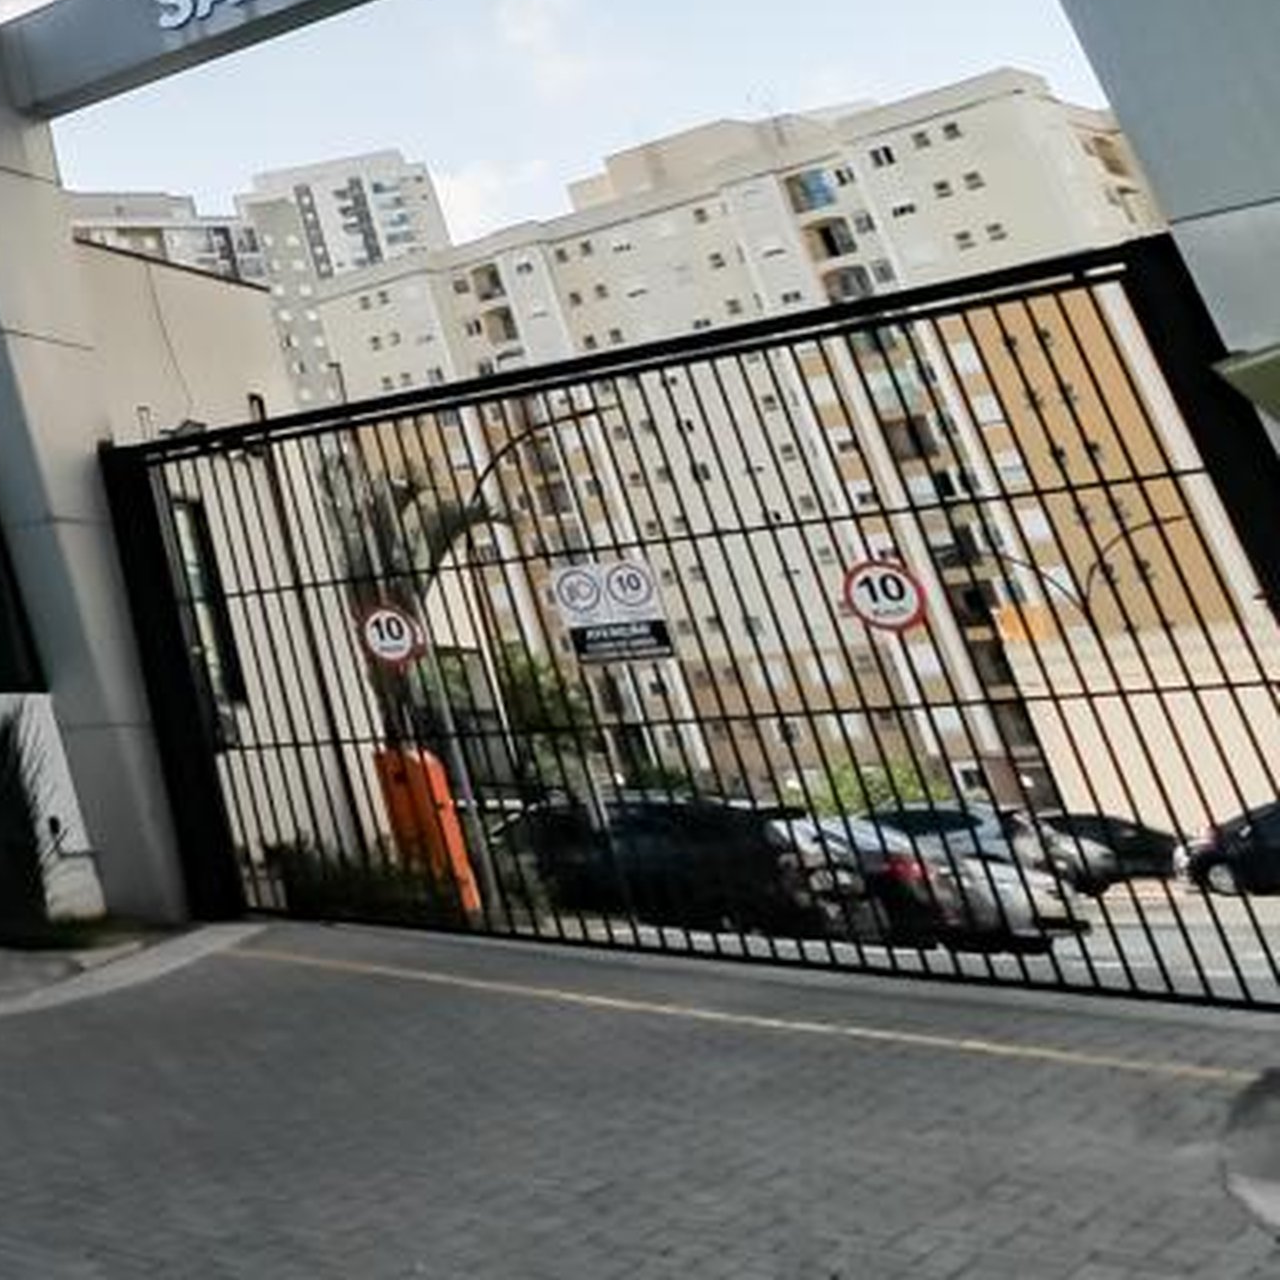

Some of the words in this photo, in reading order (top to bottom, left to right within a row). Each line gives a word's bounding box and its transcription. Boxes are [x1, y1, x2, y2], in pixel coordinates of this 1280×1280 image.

[617, 573, 641, 593] 10
[857, 573, 905, 603] 10
[371, 616, 405, 641] 10
